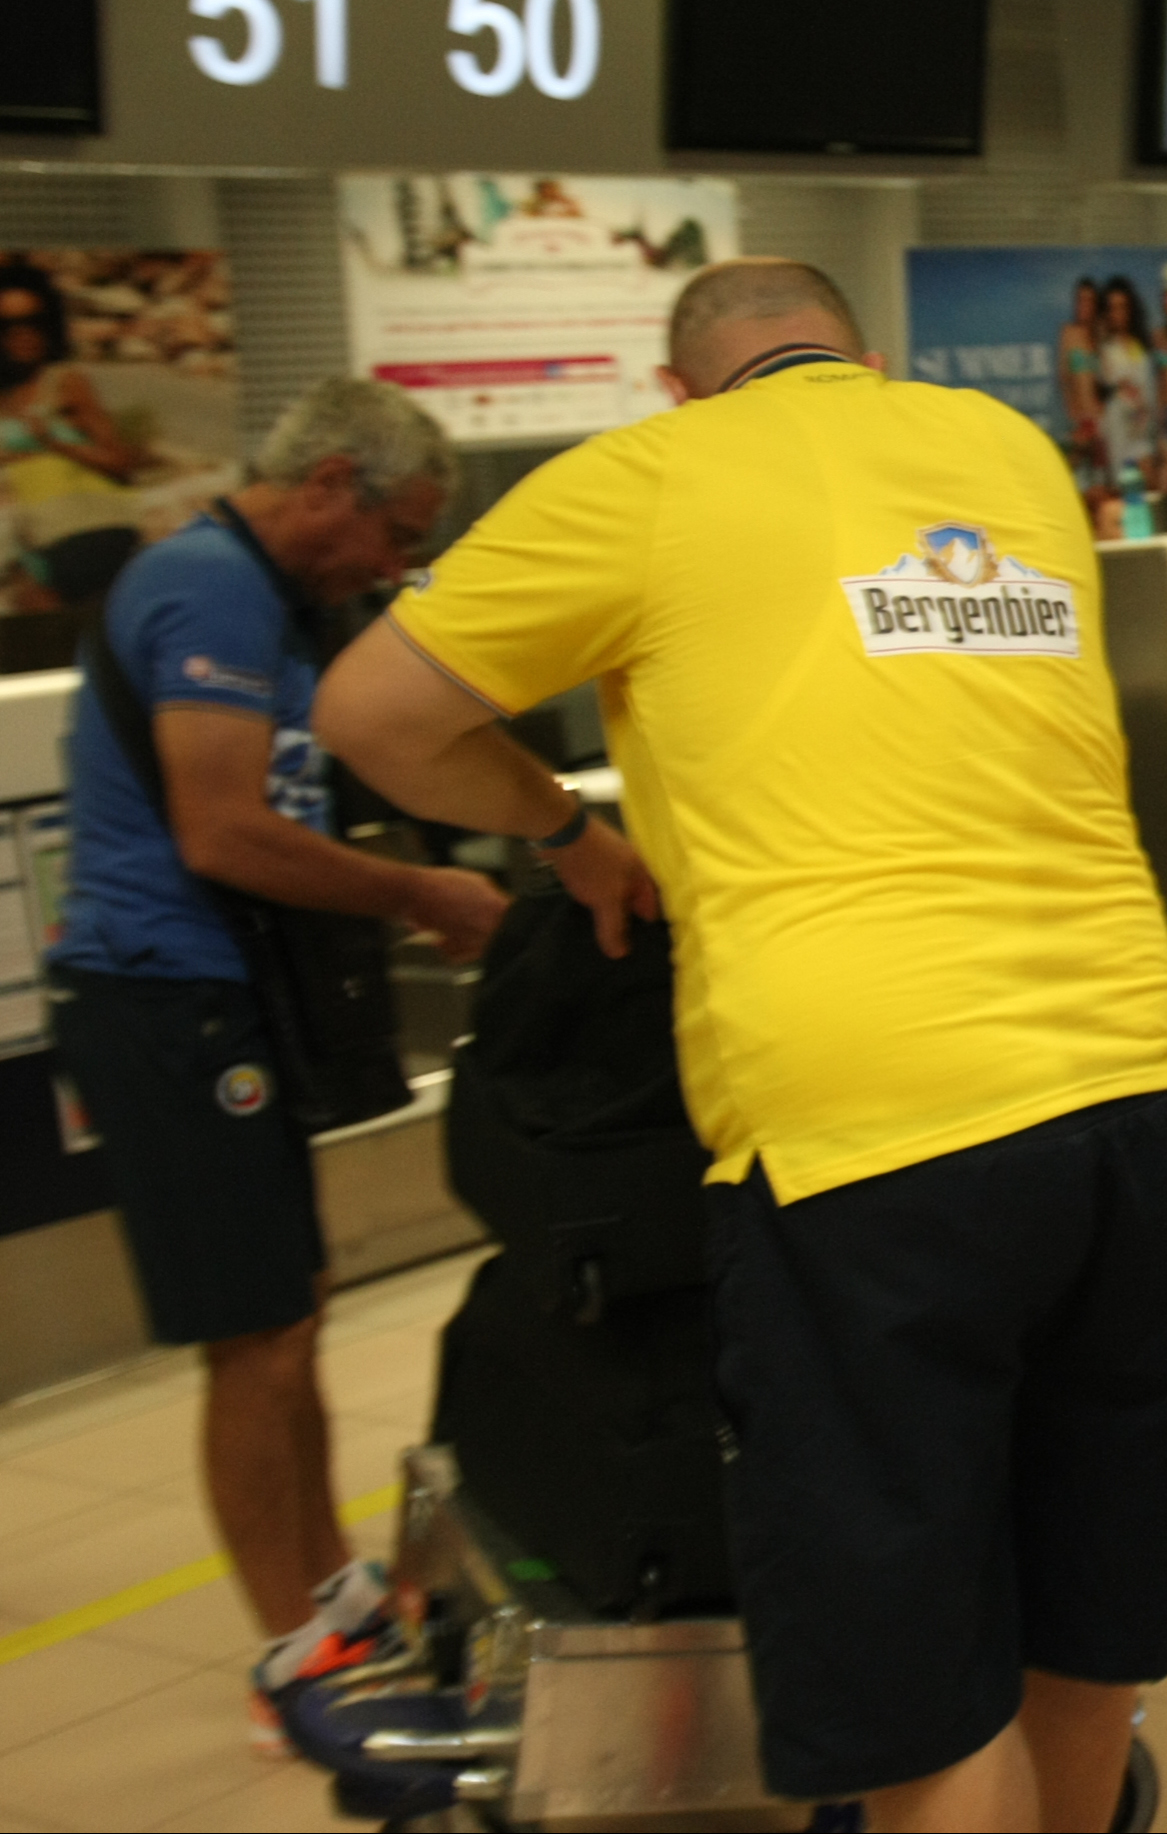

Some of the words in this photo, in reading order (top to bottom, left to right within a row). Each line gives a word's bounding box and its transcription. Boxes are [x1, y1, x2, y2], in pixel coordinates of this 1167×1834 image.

[188, 0, 350, 90] 51
[446, 0, 601, 100] 50
[861, 585, 1069, 644] Bergenbier
